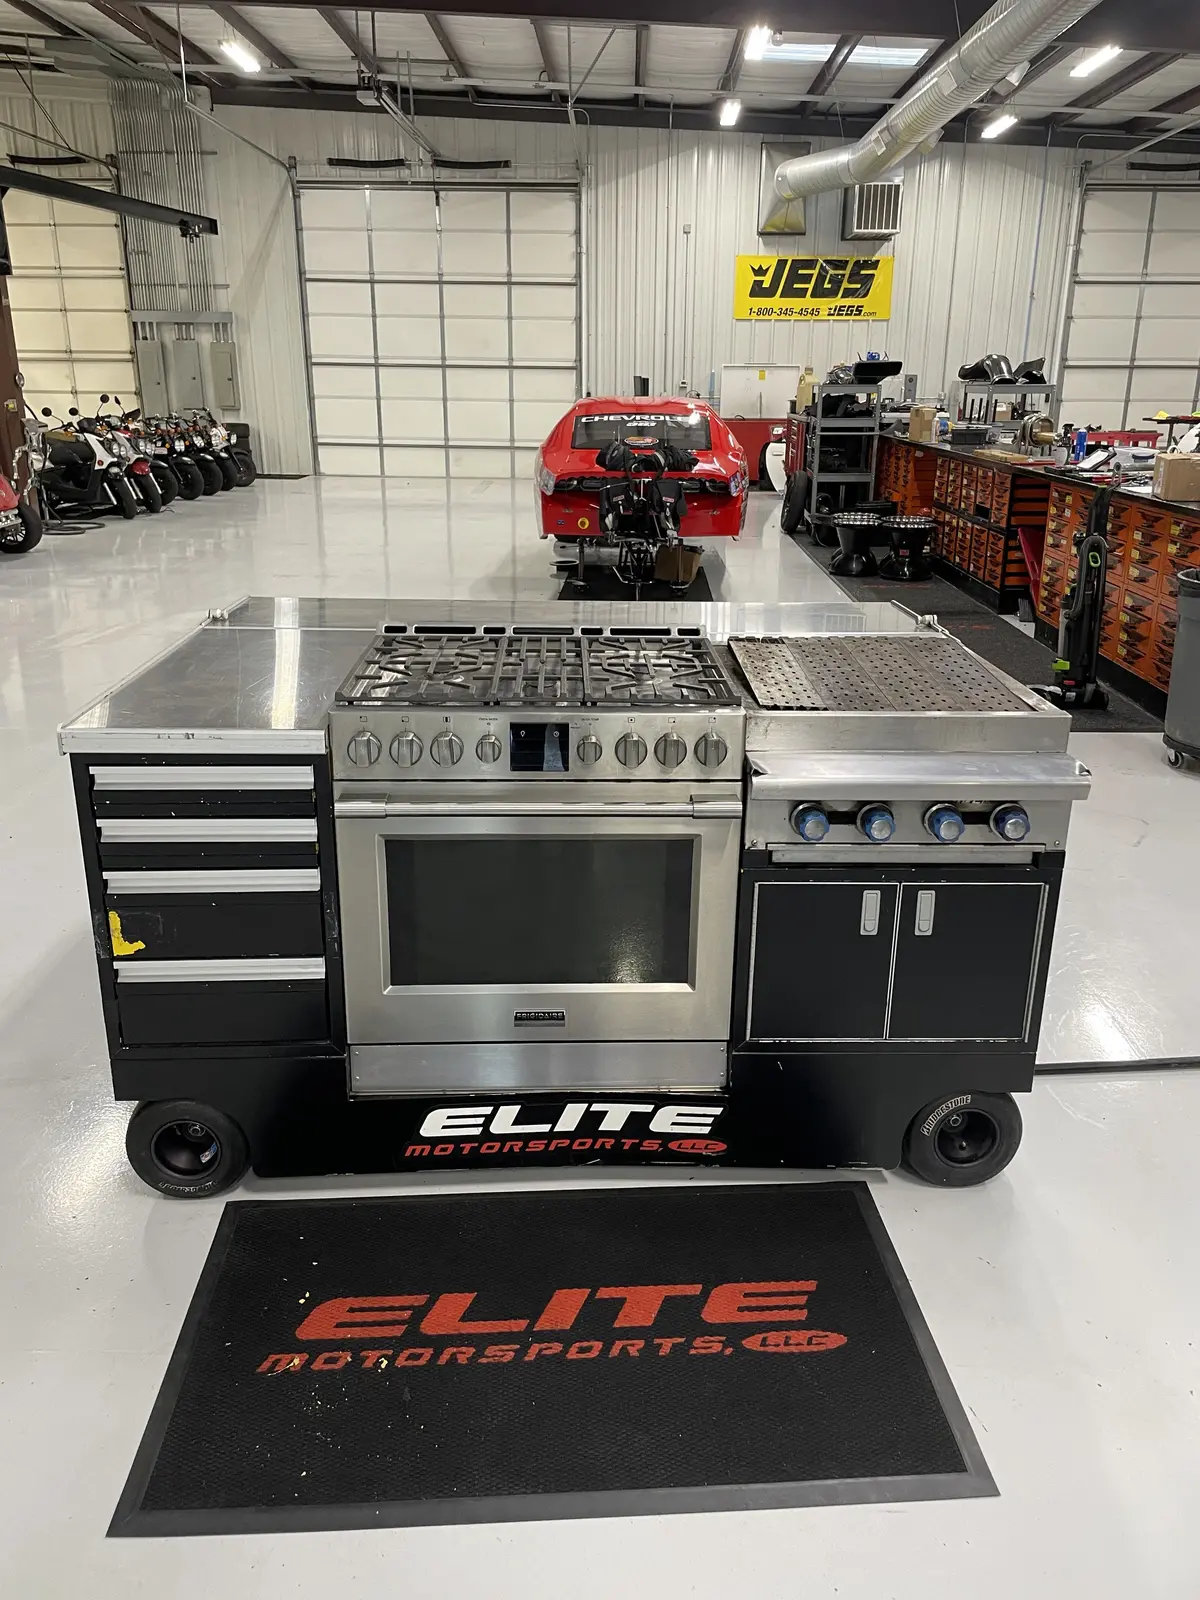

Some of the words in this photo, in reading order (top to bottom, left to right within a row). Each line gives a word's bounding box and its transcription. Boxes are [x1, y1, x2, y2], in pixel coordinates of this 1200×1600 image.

[749, 258, 880, 299] JEGS
[748, 307, 820, 316] 1-800-345-4545
[581, 414, 697, 423] CHEVROLE
[516, 1012, 563, 1020] FRIGIDAIRE
[419, 1103, 724, 1138] ELITE
[920, 1094, 972, 1137] BRIDGESTONE
[295, 1280, 818, 1340] ELITE
[758, 1334, 830, 1348] LLC
